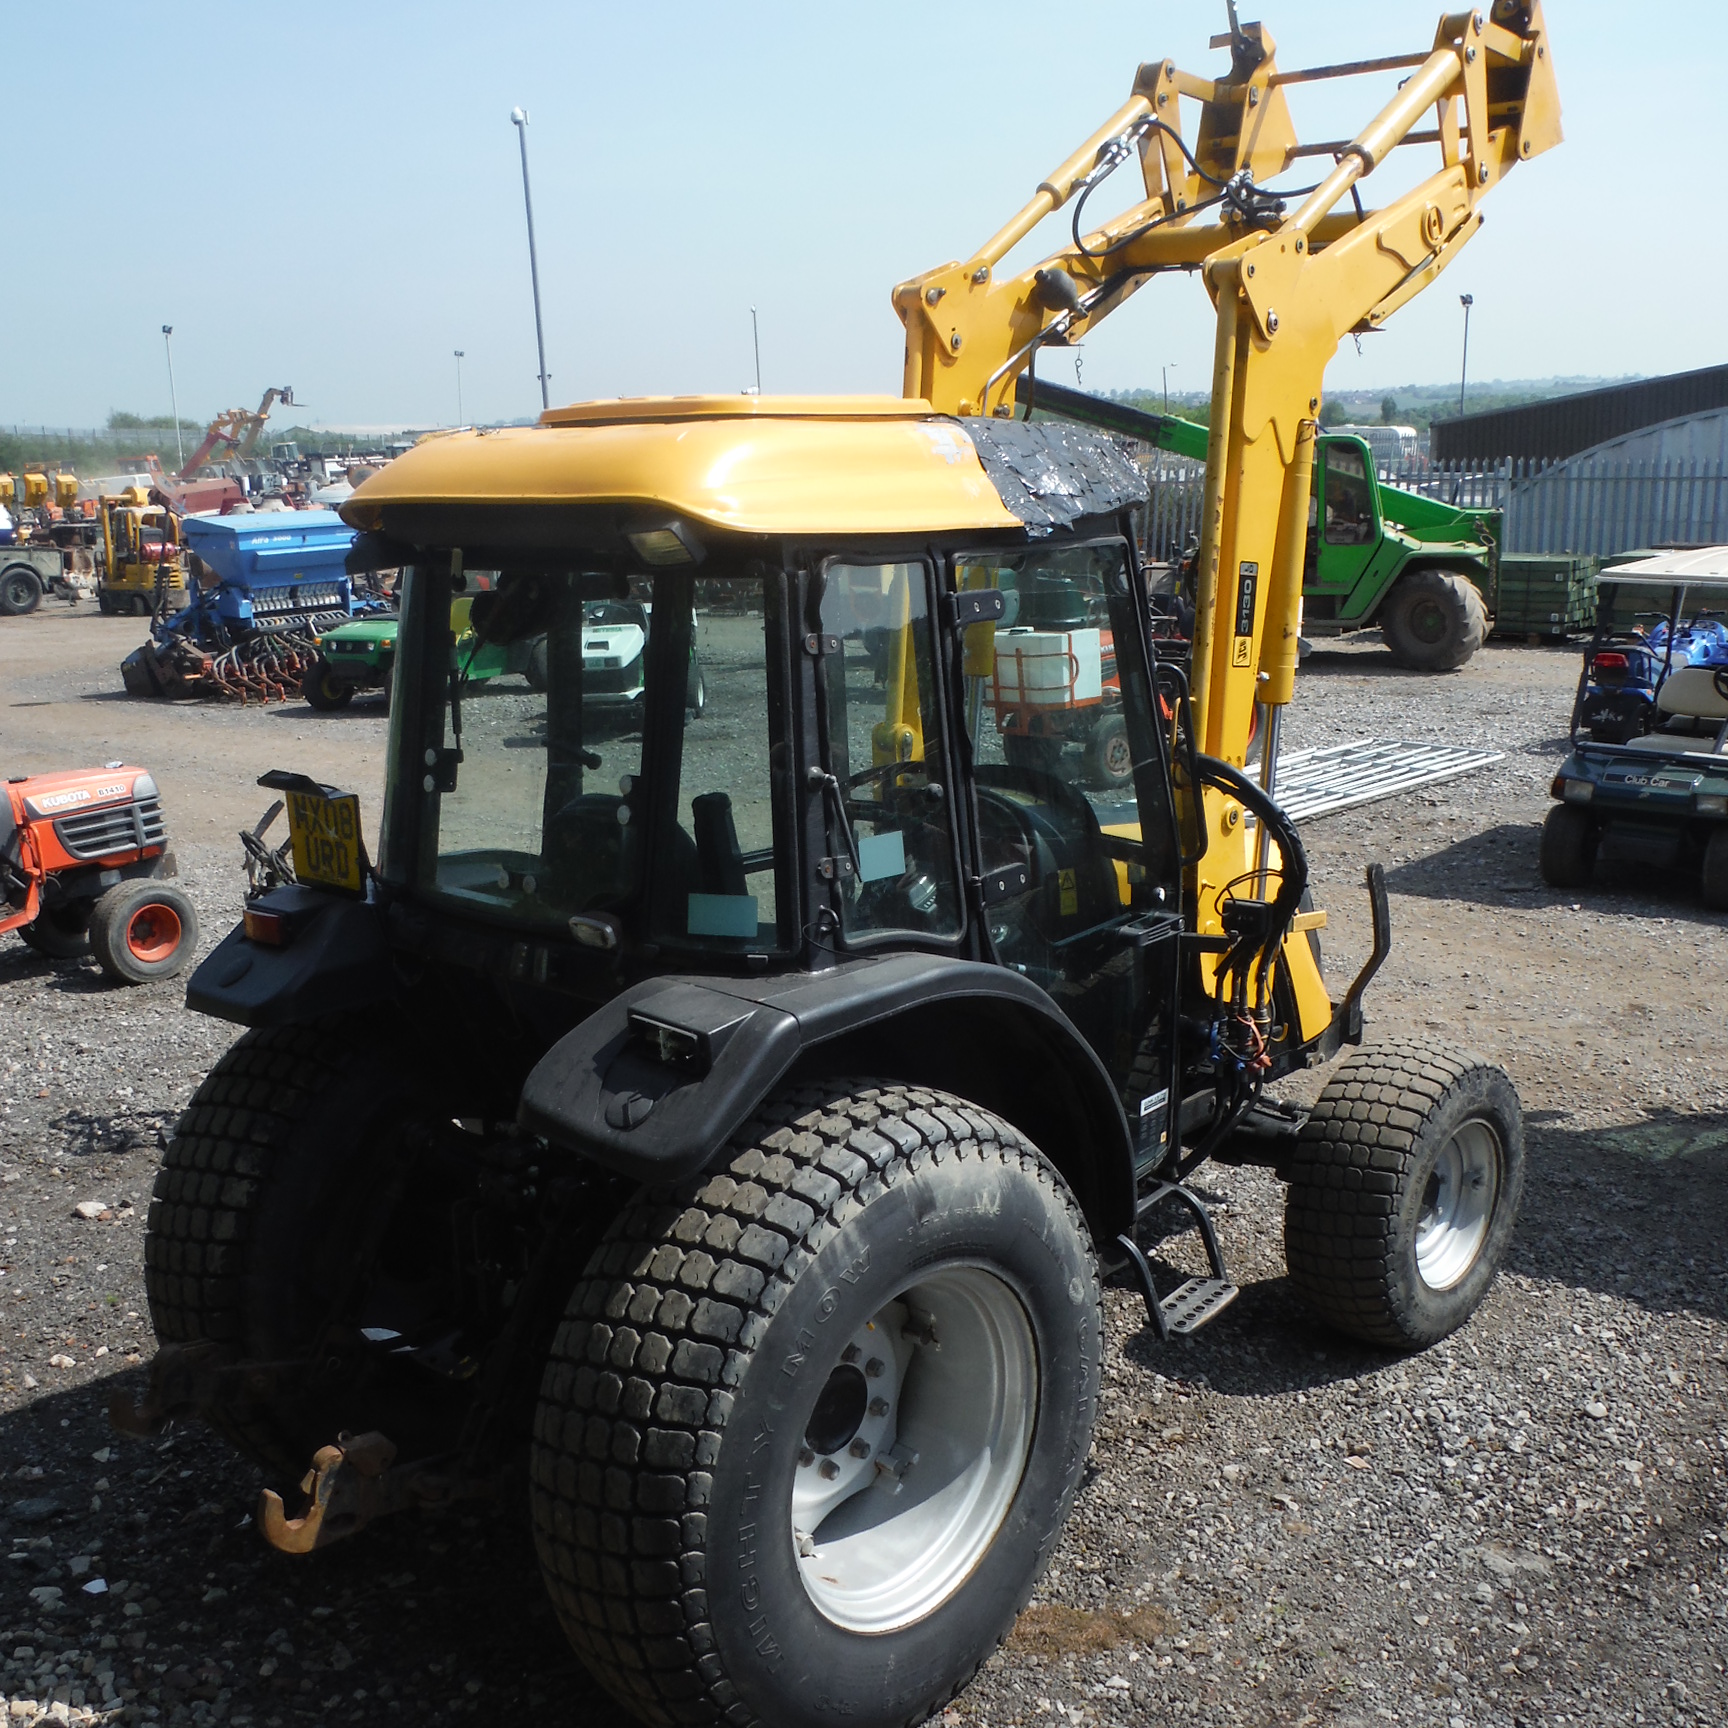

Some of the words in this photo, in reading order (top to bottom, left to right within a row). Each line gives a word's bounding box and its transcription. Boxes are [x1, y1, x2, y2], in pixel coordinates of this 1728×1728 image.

[1241, 579, 1252, 633] 3130
[1236, 639, 1247, 659] JCB
[1624, 774, 1648, 785] Club
[1650, 777, 1670, 788] Car
[41, 789, 91, 809] KUBOTA
[305, 836, 351, 880] URD
[737, 1416, 784, 1676] MIGHTY
[780, 1244, 872, 1377] MOW
